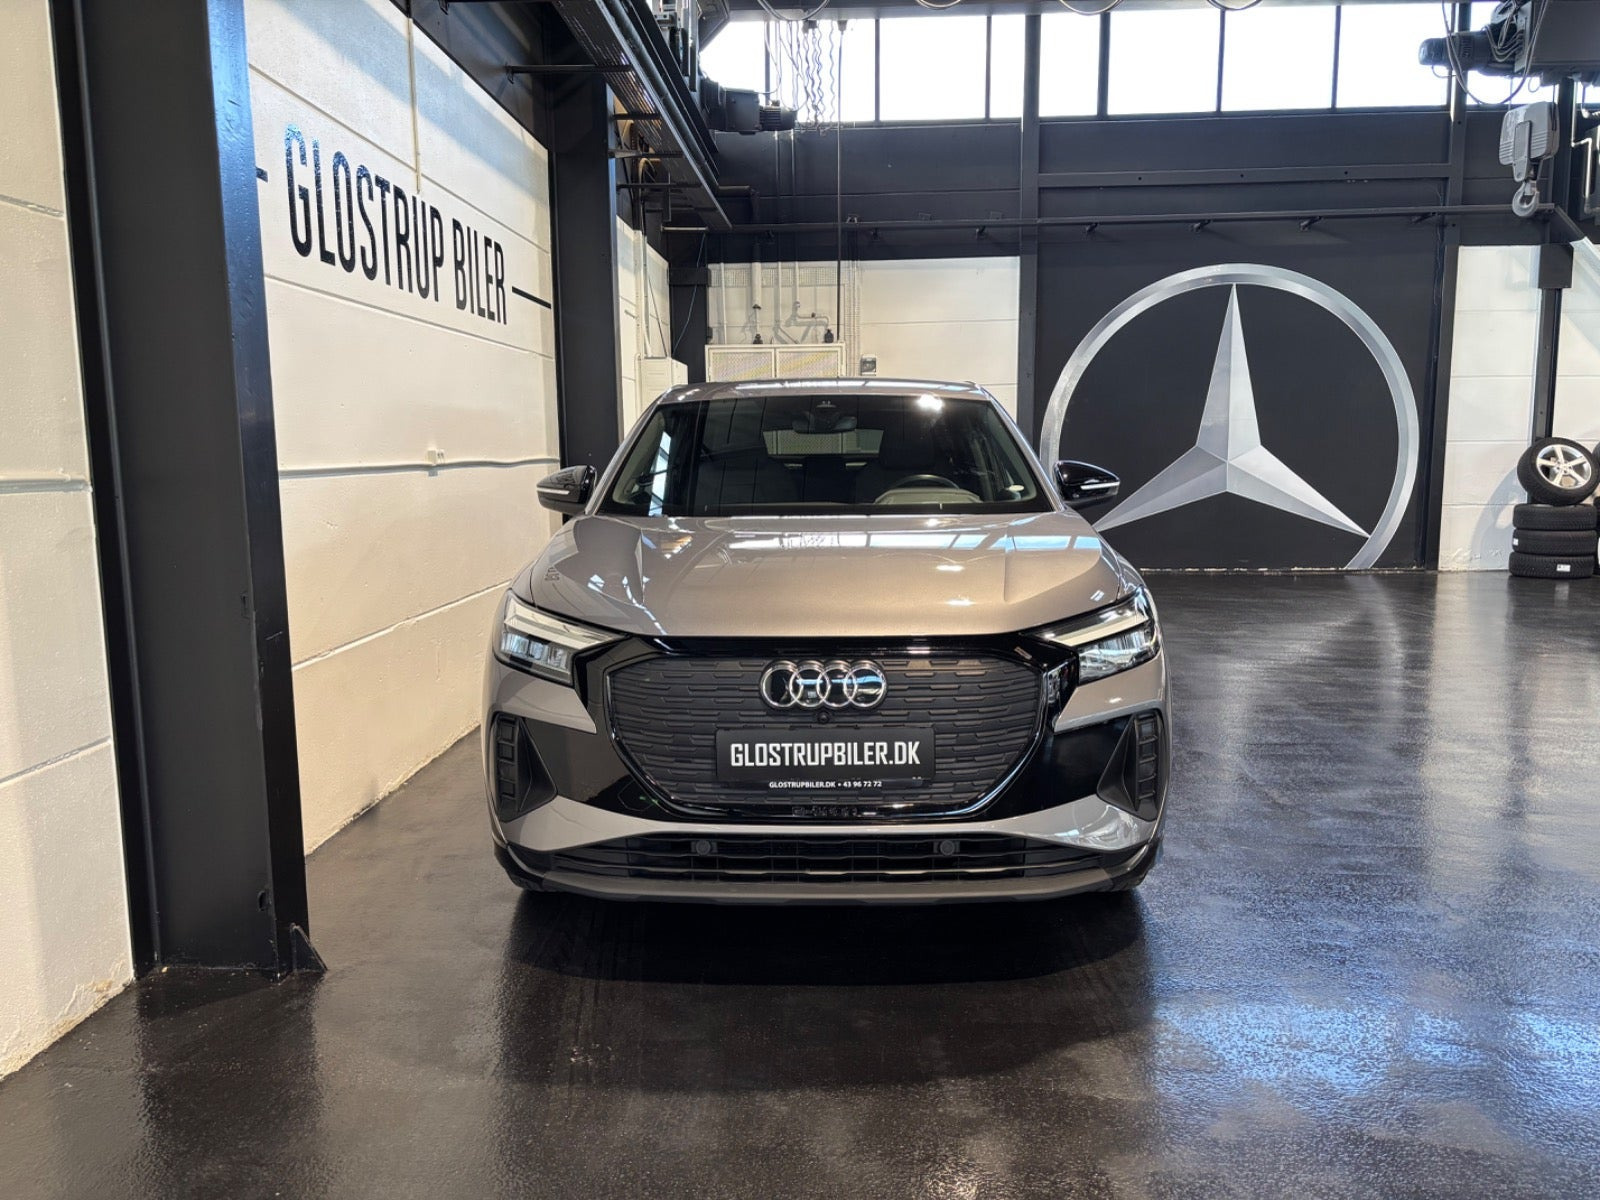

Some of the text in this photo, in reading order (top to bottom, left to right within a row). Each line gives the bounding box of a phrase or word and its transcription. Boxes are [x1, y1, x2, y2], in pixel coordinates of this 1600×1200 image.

[284, 123, 507, 325] GLOSTRUP BILER
[730, 741, 921, 767] GLOSTRUPBILER.DK
[843, 780, 852, 788] 43
[853, 780, 862, 788] 96
[863, 780, 872, 788] 72
[873, 780, 882, 788] 72
